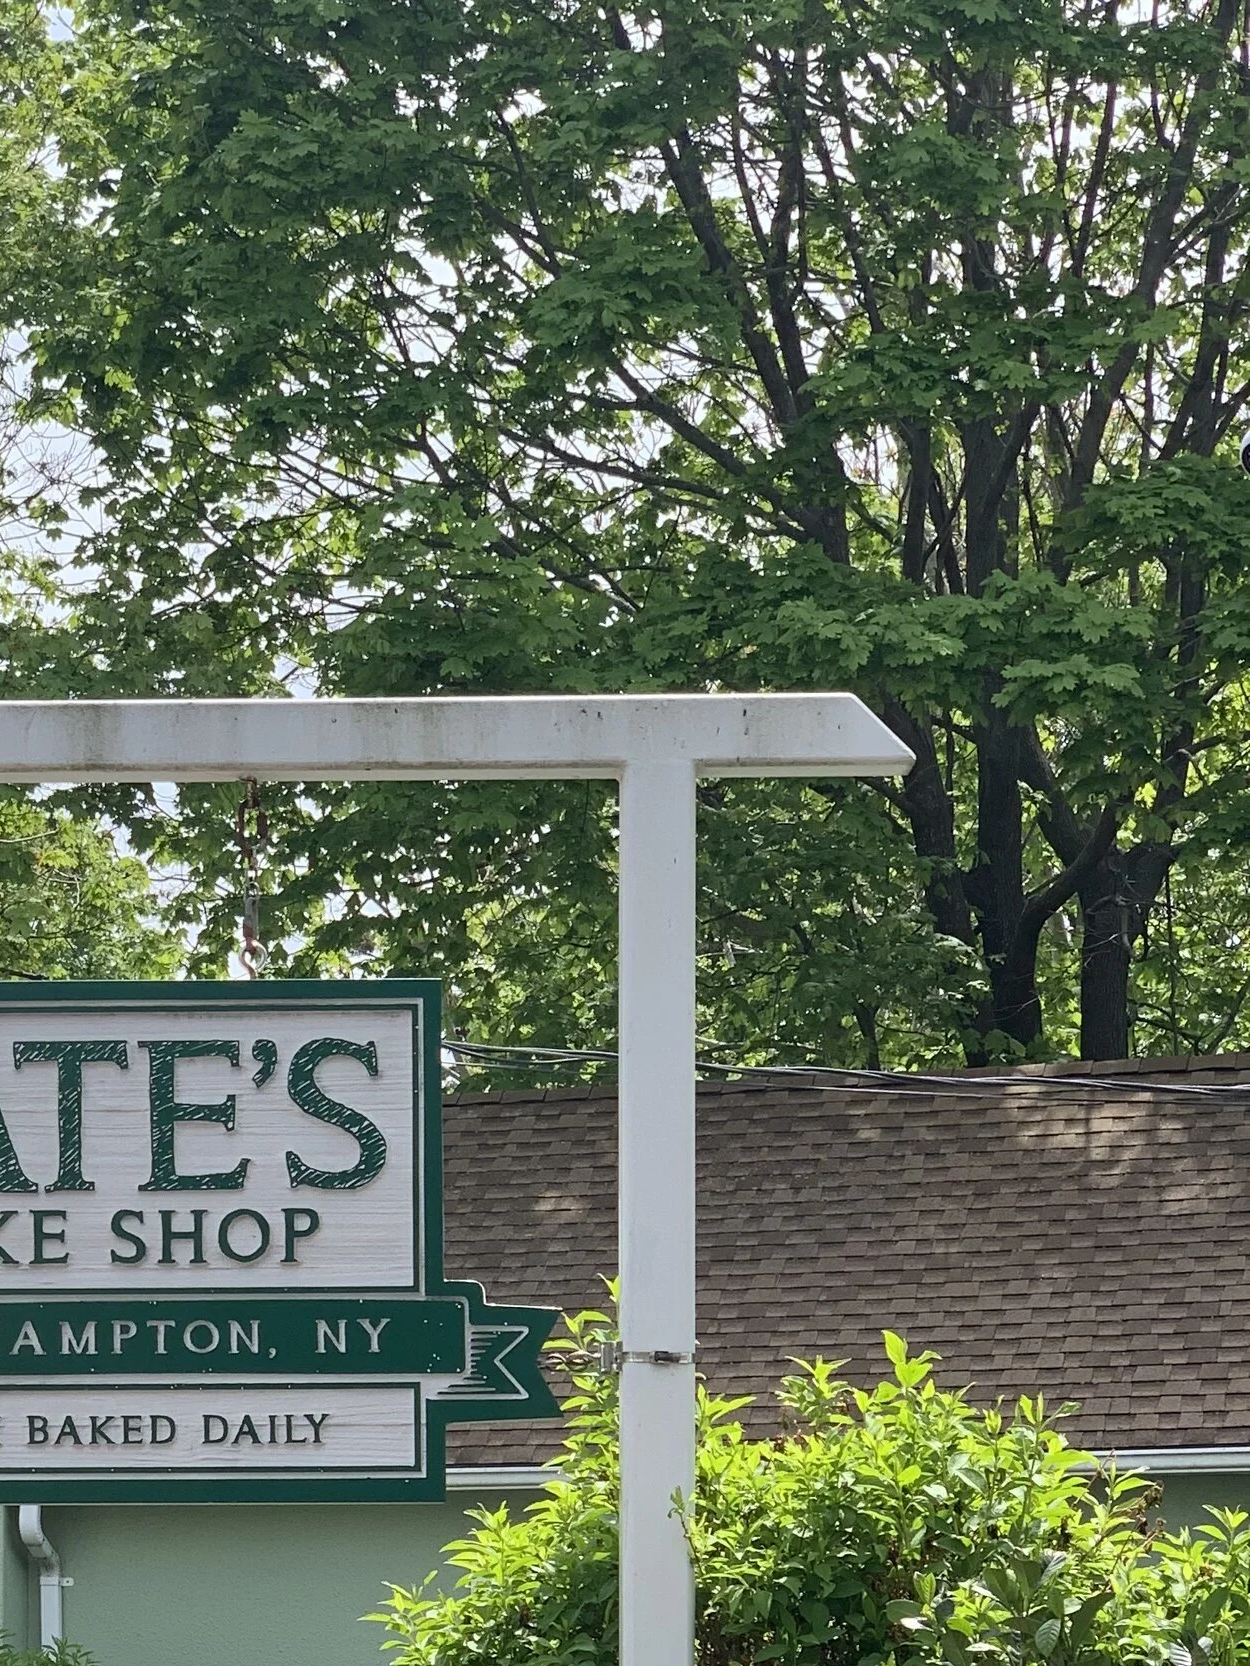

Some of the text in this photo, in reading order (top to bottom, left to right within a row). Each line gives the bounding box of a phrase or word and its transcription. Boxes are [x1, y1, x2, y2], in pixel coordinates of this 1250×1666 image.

[109, 1207, 321, 1265] SHOP
[314, 1317, 392, 1354] NY
[27, 1414, 178, 1446] BAKED
[201, 1412, 332, 1446] DAILY
